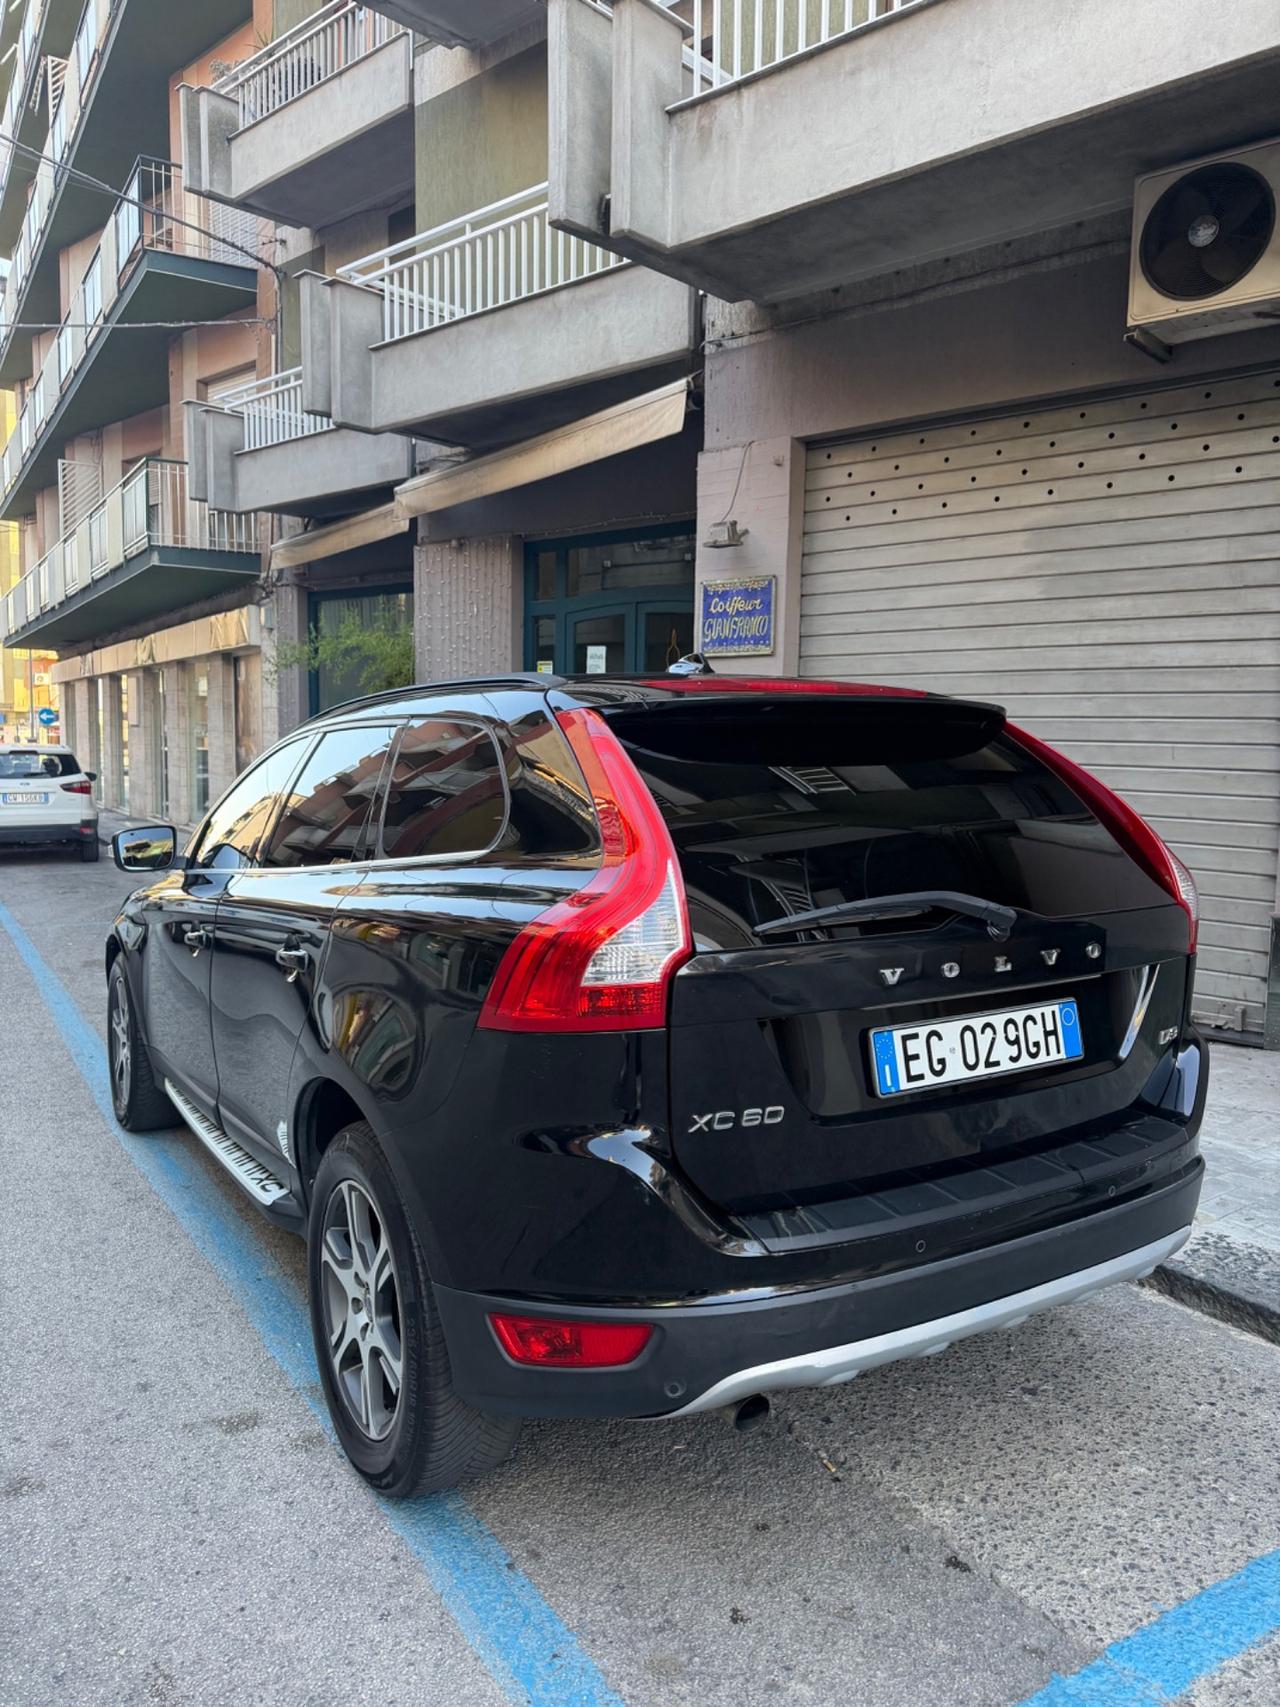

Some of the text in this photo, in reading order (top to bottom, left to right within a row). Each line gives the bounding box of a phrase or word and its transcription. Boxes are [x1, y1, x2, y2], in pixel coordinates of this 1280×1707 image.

[709, 597, 764, 615] Coiffeur
[704, 616, 769, 642] GIANFRANCO
[880, 943, 1102, 986] VOLVO
[900, 1029, 947, 1084] EG
[959, 1009, 1062, 1072] 029GH
